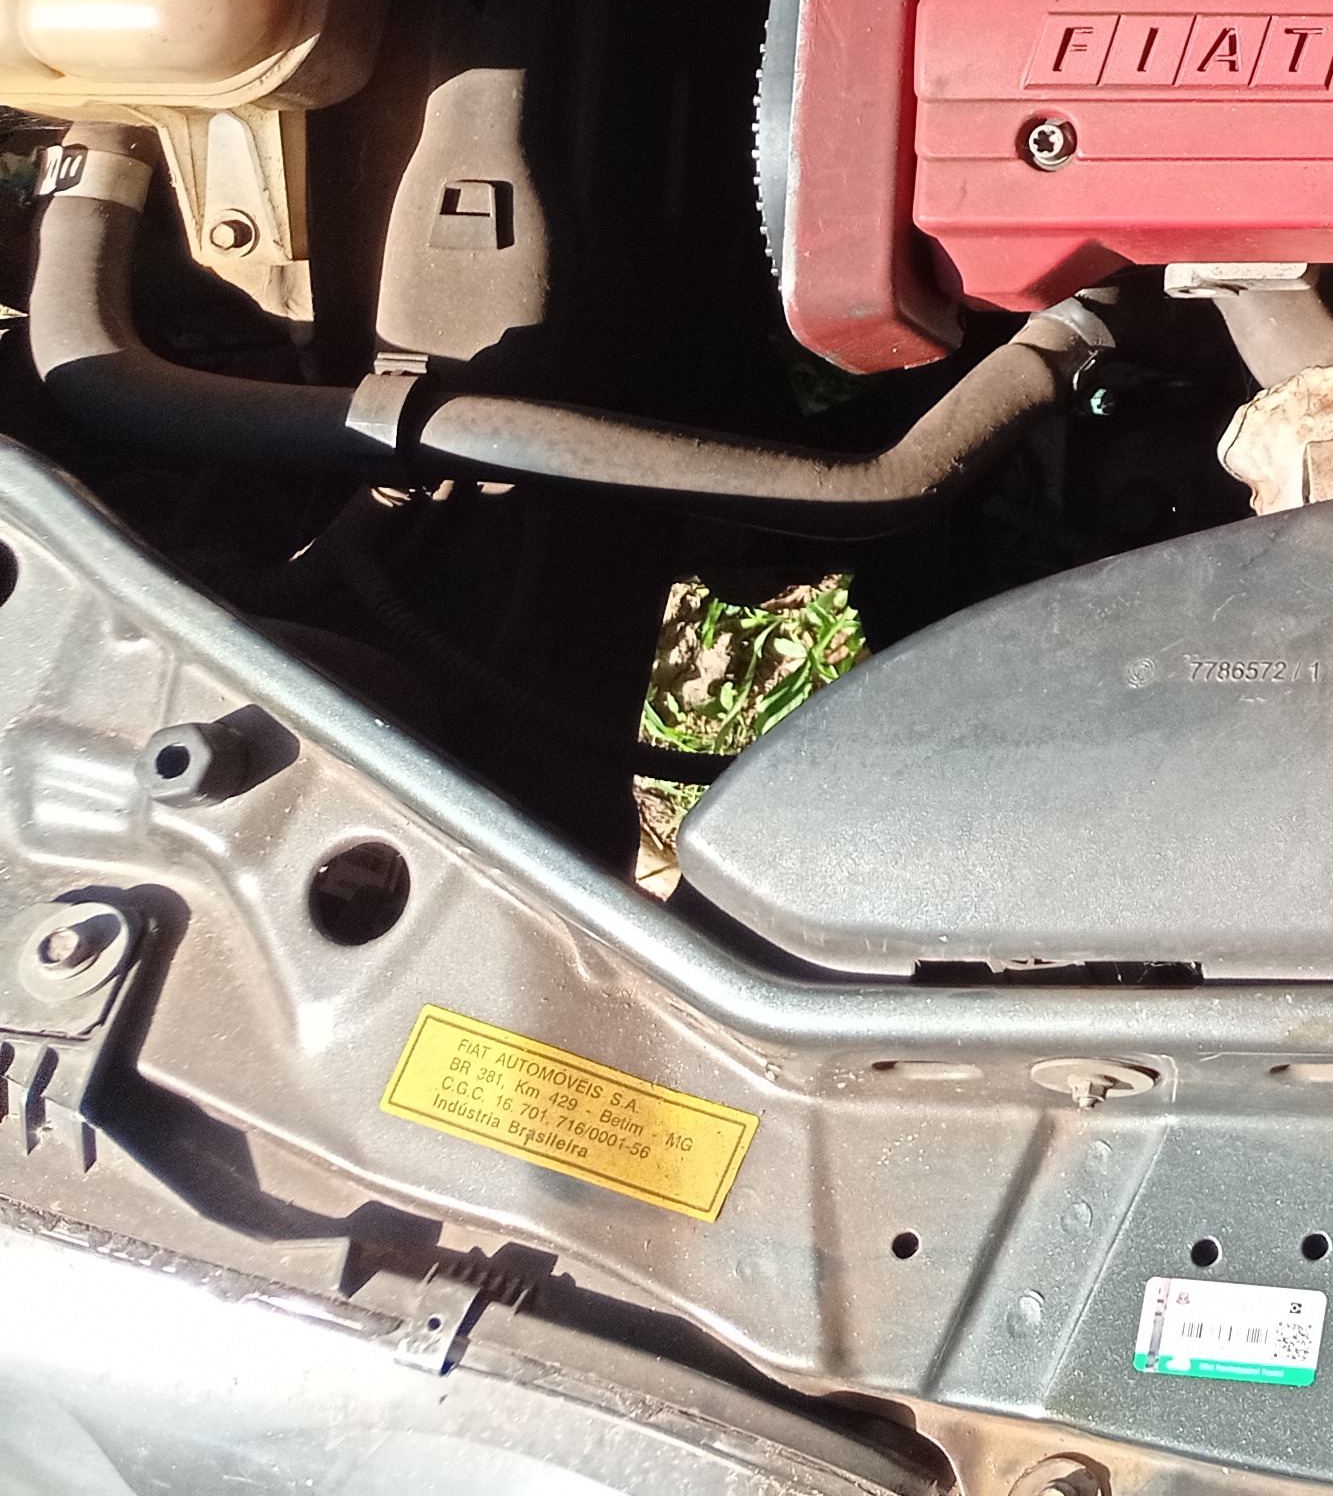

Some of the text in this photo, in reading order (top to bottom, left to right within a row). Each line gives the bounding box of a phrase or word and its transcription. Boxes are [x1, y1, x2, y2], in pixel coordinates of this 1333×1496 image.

[1052, 26, 1328, 73] FIAT
[1189, 660, 1287, 682] 7786572
[447, 1055, 473, 1076] BR
[474, 1065, 510, 1091] 381,
[513, 1078, 542, 1099] Km
[546, 1089, 580, 1112] 429
[597, 1108, 646, 1137] Betim
[663, 1130, 695, 1154] MG
[455, 1037, 644, 1115] FIAT AUTOMÓVEIS S.A.
[430, 1092, 592, 1159] Indústria Brasileira
[438, 1074, 489, 1103] C.G.C.
[553, 1113, 653, 1160] 716/0001-56
